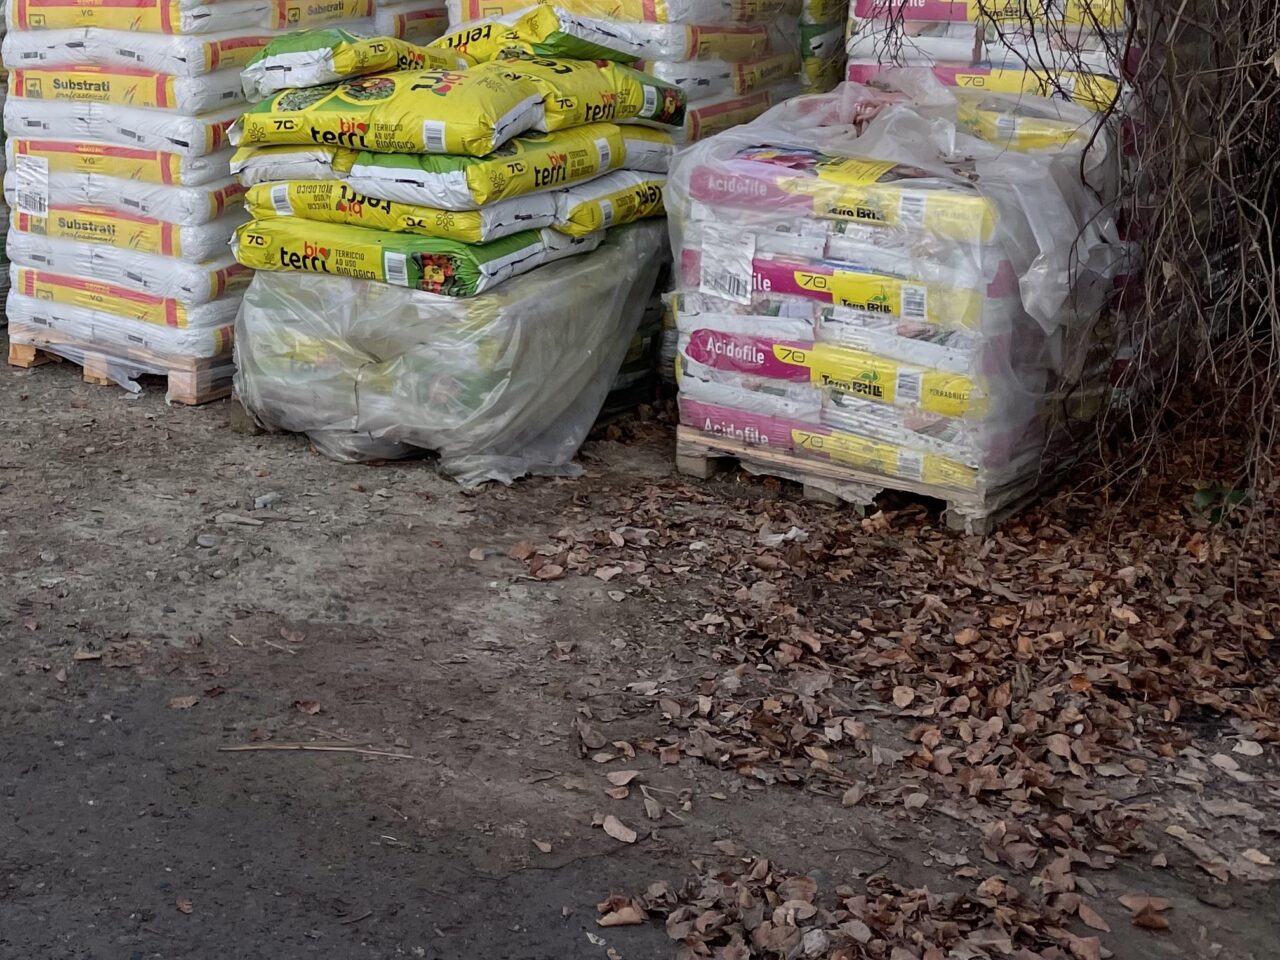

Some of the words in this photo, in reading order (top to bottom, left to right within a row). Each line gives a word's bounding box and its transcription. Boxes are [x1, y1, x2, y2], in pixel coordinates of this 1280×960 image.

[447, 24, 492, 48] terri
[53, 78, 111, 92] Substrati
[584, 102, 616, 122] terri
[339, 117, 370, 133] bio
[373, 123, 404, 132] TERRICCIO
[310, 126, 369, 149] terri
[374, 132, 382, 140] AD
[382, 132, 396, 140] USO
[375, 140, 416, 150] BIOLOGICO
[82, 157, 96, 165] VG
[546, 151, 568, 168] bio
[534, 166, 566, 188] terri
[708, 176, 768, 197] Acidofile
[339, 185, 392, 215] terri
[335, 200, 363, 218] bio
[828, 206, 855, 217] erra
[58, 216, 116, 236] Substrati
[303, 241, 331, 259] bio
[335, 249, 365, 261] TERRICCIO
[280, 246, 330, 273] terri
[335, 258, 343, 266] AD
[344, 259, 357, 268] USO
[336, 267, 376, 280] BIOLOGICO
[801, 274, 827, 289] 70
[706, 336, 765, 365] Acidofile
[780, 348, 806, 364] 70
[852, 380, 883, 398] BRILL
[704, 417, 769, 445] Acidofile
